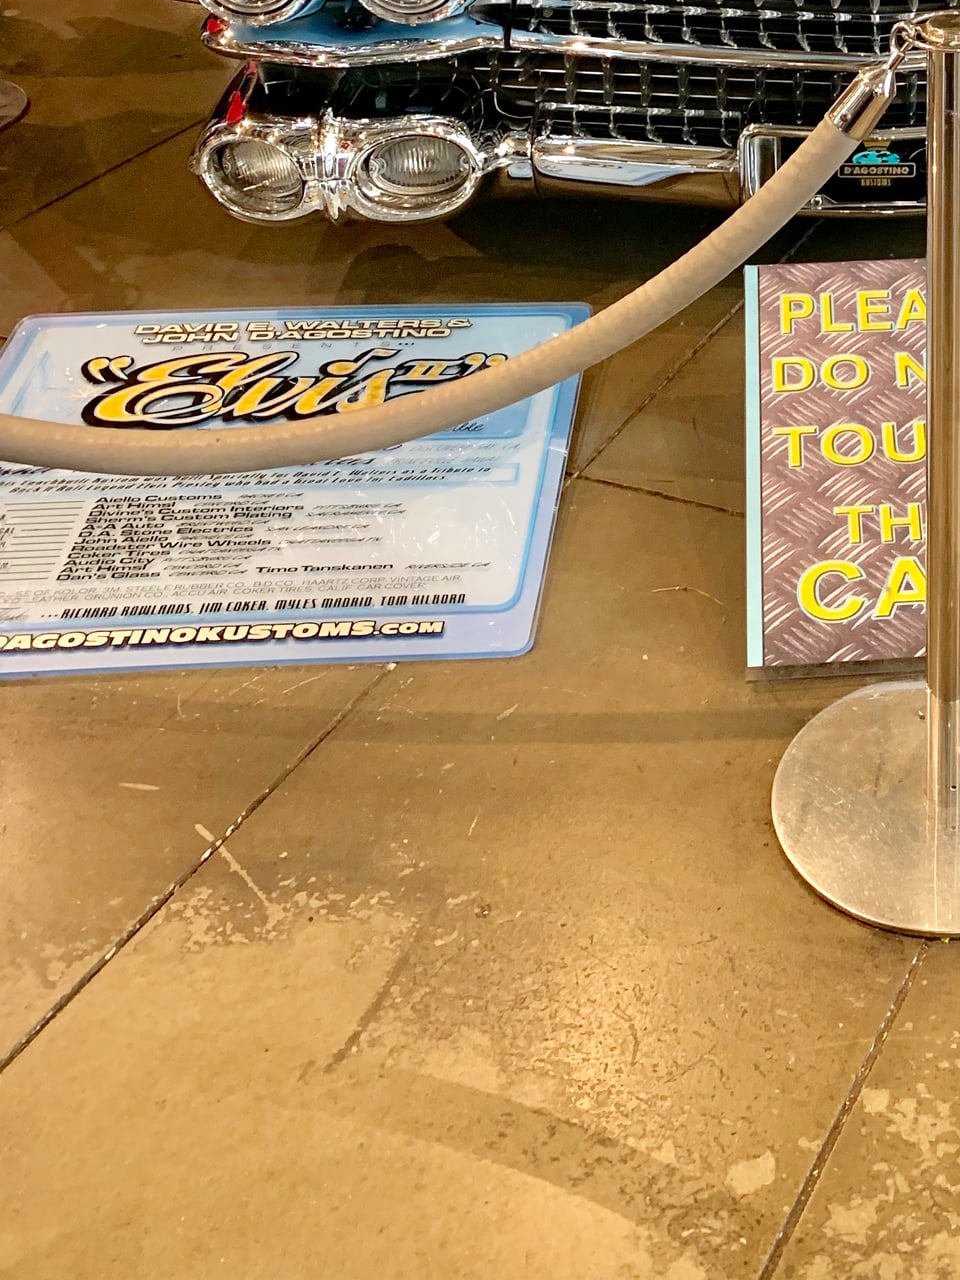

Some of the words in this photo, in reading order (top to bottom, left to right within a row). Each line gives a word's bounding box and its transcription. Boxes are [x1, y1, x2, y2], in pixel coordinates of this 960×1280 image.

[843, 165, 910, 175] D'AGOSTINO
[134, 323, 240, 335] DAVID
[284, 319, 447, 331] WALTERS
[448, 318, 473, 328] &
[141, 332, 240, 344] JOHN
[248, 328, 453, 342] D'AGOSTINO
[771, 352, 871, 394] DO
[144, 494, 223, 503] Customs
[92, 502, 126, 510] Art
[158, 507, 227, 516] Custom
[230, 504, 305, 512] Interiors
[160, 513, 230, 522] Custom
[233, 511, 294, 519] Plating
[120, 522, 165, 530] Auto
[832, 502, 928, 545] TH
[120, 529, 174, 537] Stone
[176, 525, 254, 535] Electrics
[71, 543, 156, 552] Roadster
[158, 541, 204, 550] Wire
[207, 539, 272, 548] Wheels
[120, 536, 169, 544] Aiello
[67, 551, 122, 559] Coker
[125, 549, 171, 557] Tires
[63, 558, 118, 566] Audio
[119, 556, 156, 566] City
[56, 573, 107, 581] Dan's
[110, 571, 162, 579] Glass
[255, 566, 299, 574] Timo
[300, 563, 394, 573] Tanskanen
[60, 565, 95, 573] Art
[199, 601, 223, 615] JIM
[274, 598, 318, 611] MYLES
[380, 595, 408, 607] TOM
[410, 593, 467, 606] HILBORN
[0, 620, 446, 652] AGOSTINOKUSTOMS.COM
